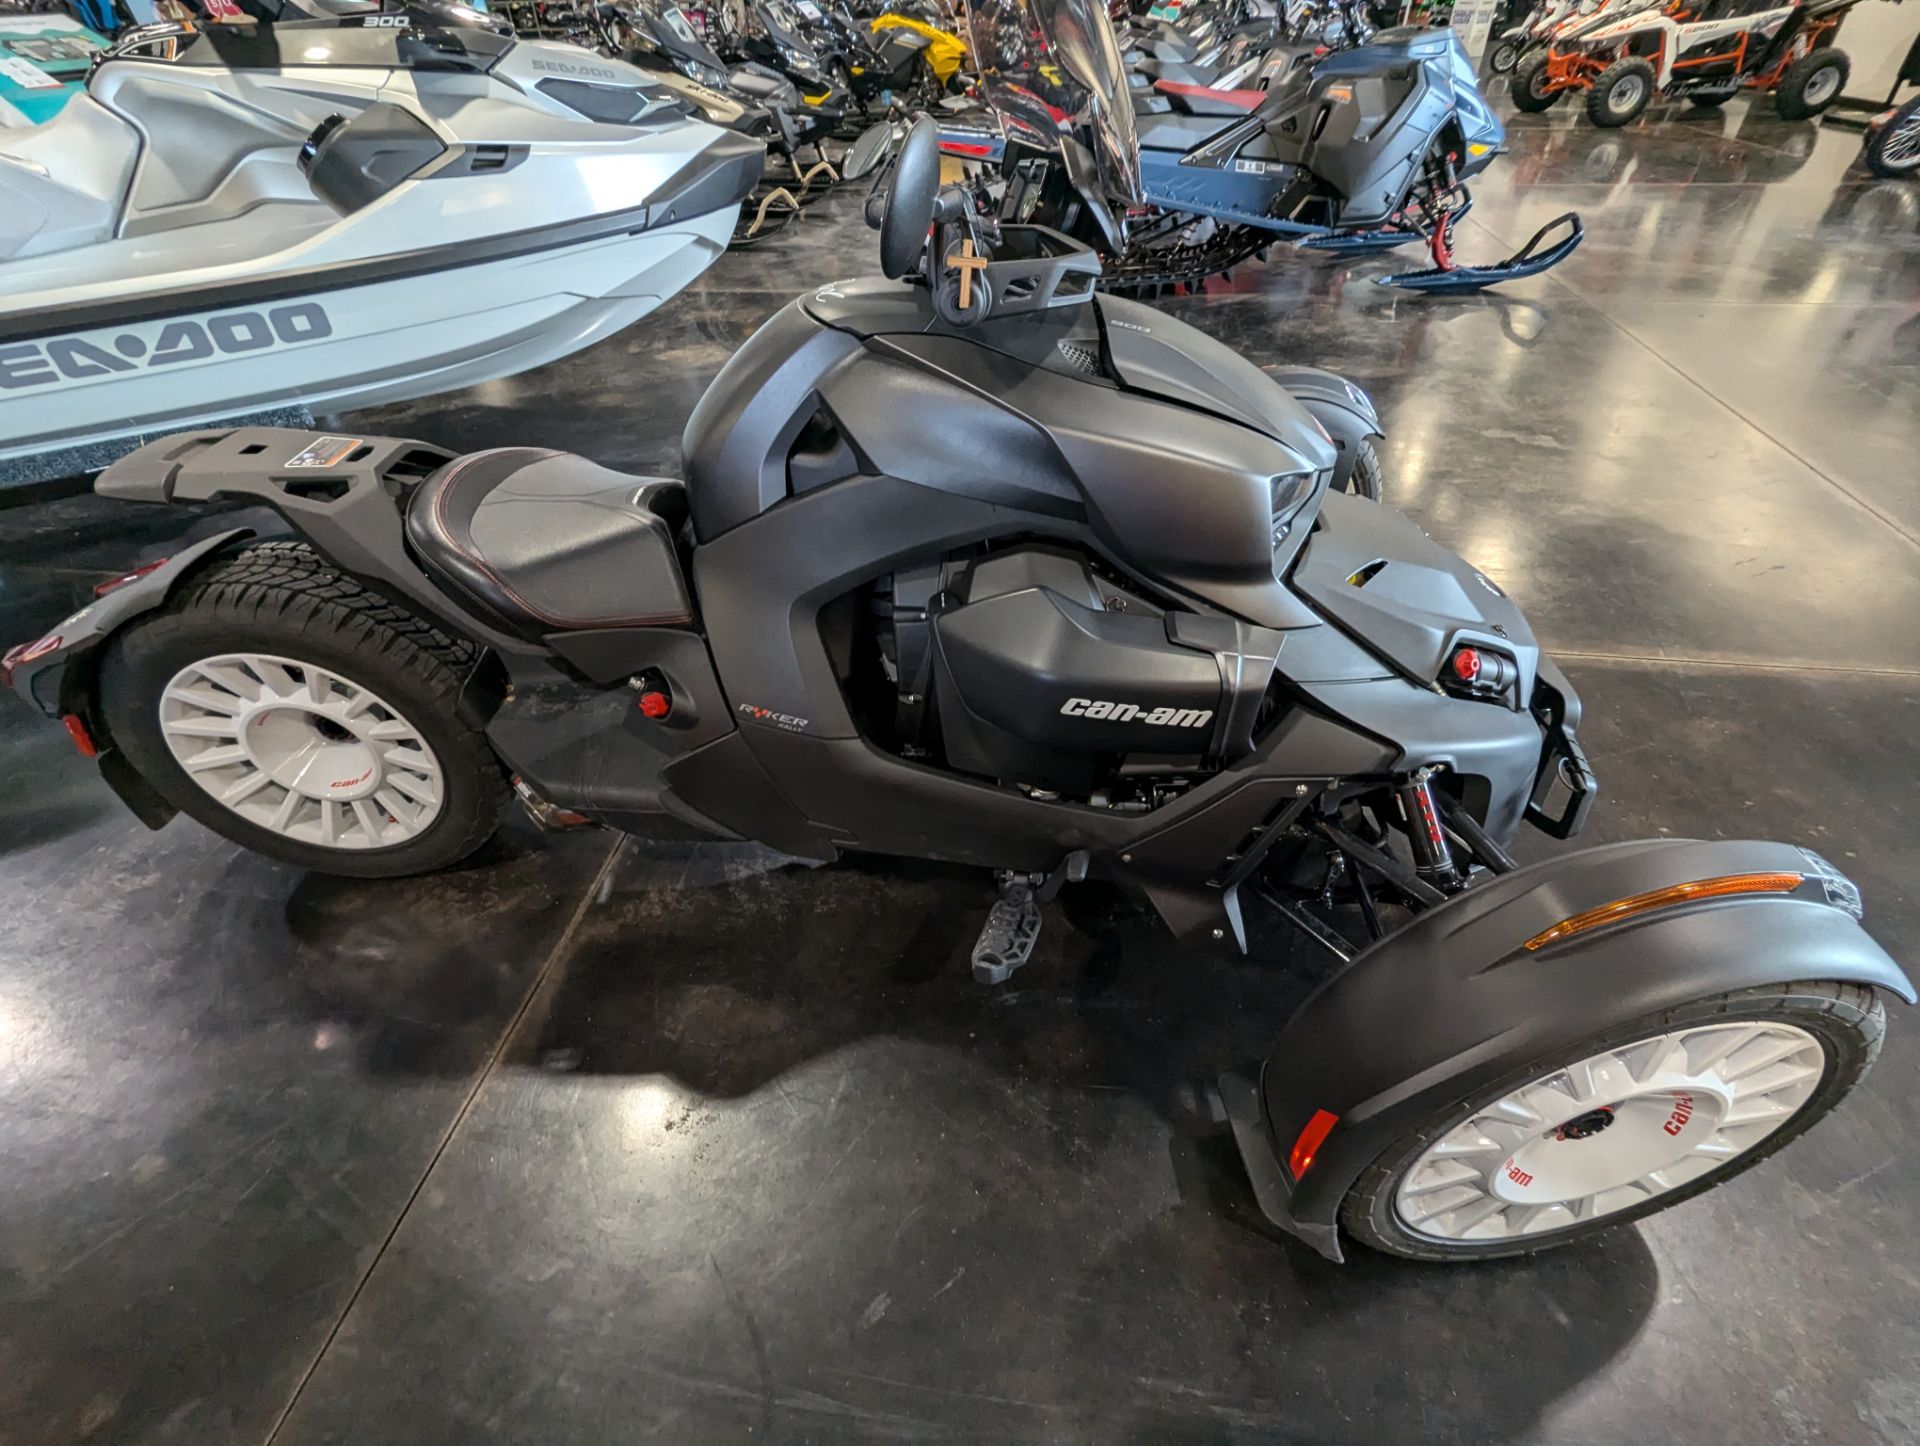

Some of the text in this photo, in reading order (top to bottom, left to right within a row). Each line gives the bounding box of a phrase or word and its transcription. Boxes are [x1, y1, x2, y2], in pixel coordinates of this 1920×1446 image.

[363, 16, 411, 28] 300
[739, 703, 809, 727] RYKER
[1060, 697, 1213, 728] can-am
[777, 722, 804, 733] RALLY
